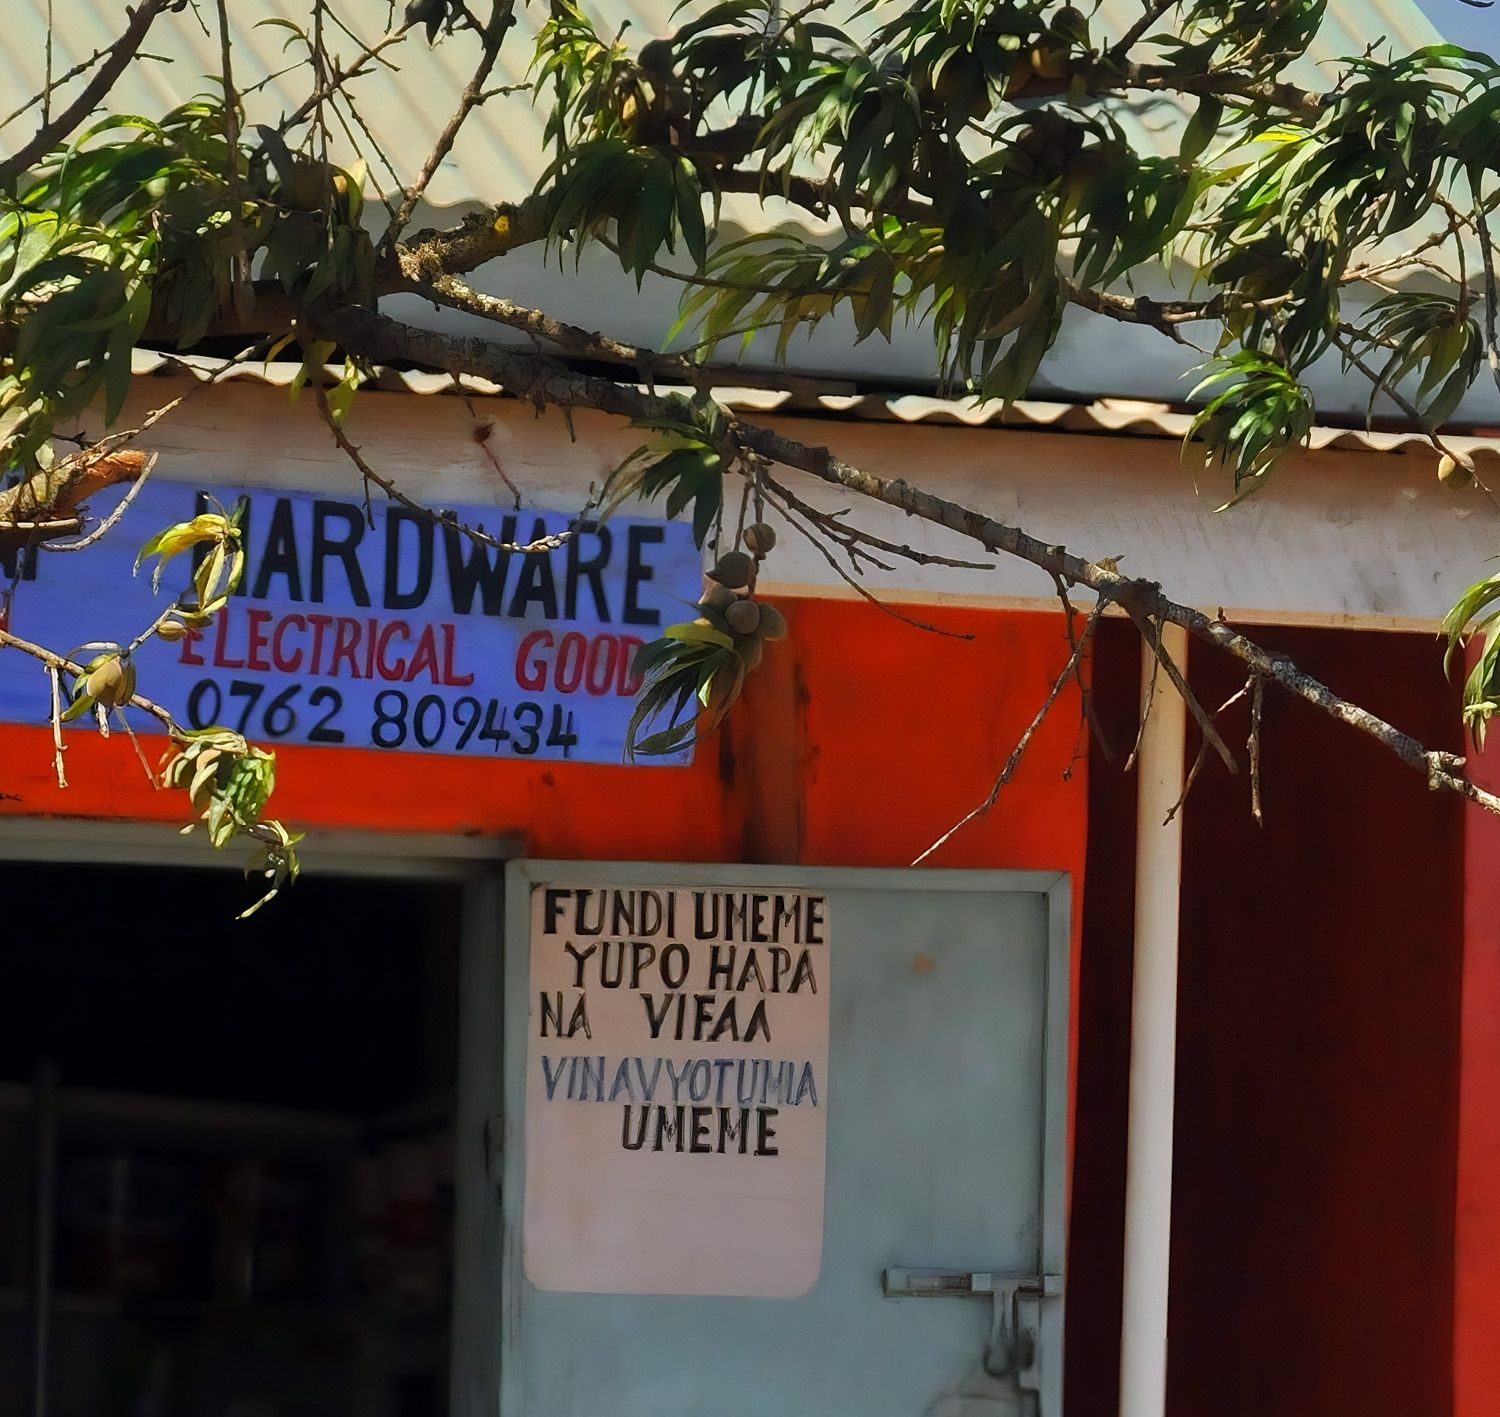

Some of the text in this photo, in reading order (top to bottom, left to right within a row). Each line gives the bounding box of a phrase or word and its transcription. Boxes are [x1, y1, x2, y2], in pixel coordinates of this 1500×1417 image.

[191, 490, 666, 626] HARDWARE
[179, 605, 647, 697] ELECTRICAL GOOD
[187, 677, 578, 759] 0762 809434
[543, 888, 824, 944] FUNDI UMEME
[564, 940, 818, 994] YUPO HAPA
[540, 991, 771, 1043] NA VIFAA
[622, 1104, 779, 1156] UMEME
